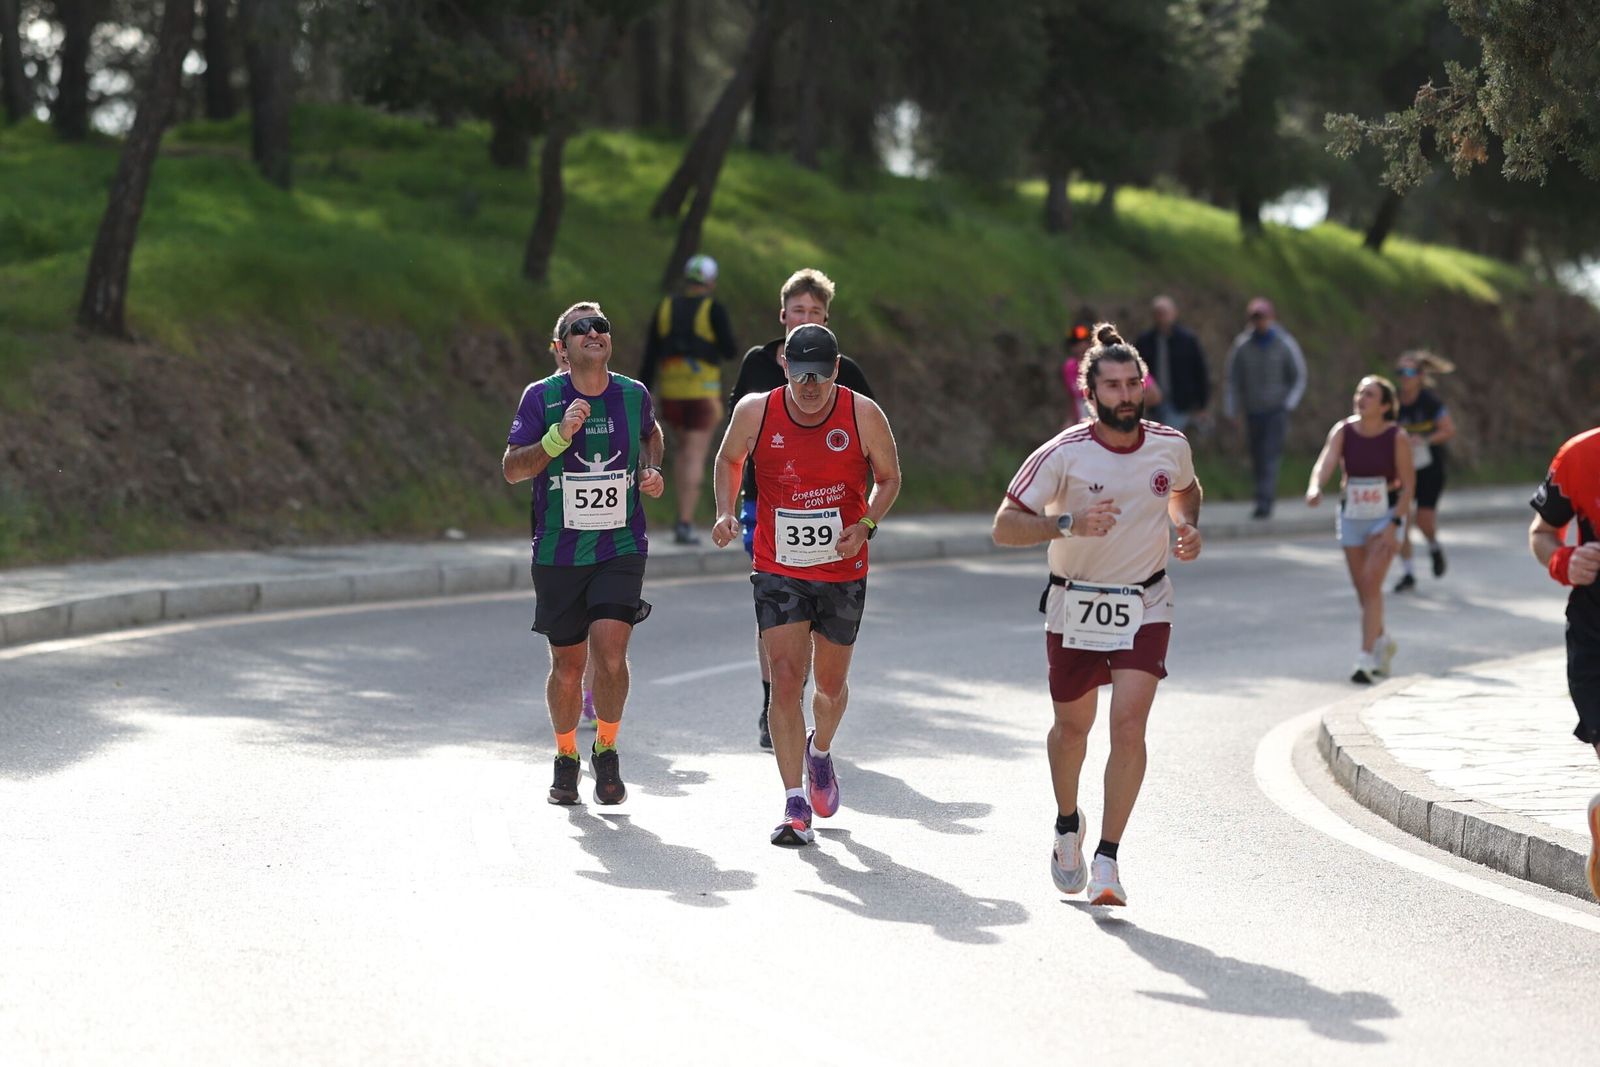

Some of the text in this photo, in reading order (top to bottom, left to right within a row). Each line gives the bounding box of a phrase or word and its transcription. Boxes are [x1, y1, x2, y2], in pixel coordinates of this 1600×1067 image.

[575, 486, 618, 509] 528
[791, 482, 846, 502] CORREDORES
[804, 496, 824, 509] CON
[786, 525, 833, 546] 339
[1078, 600, 1130, 627] 705
